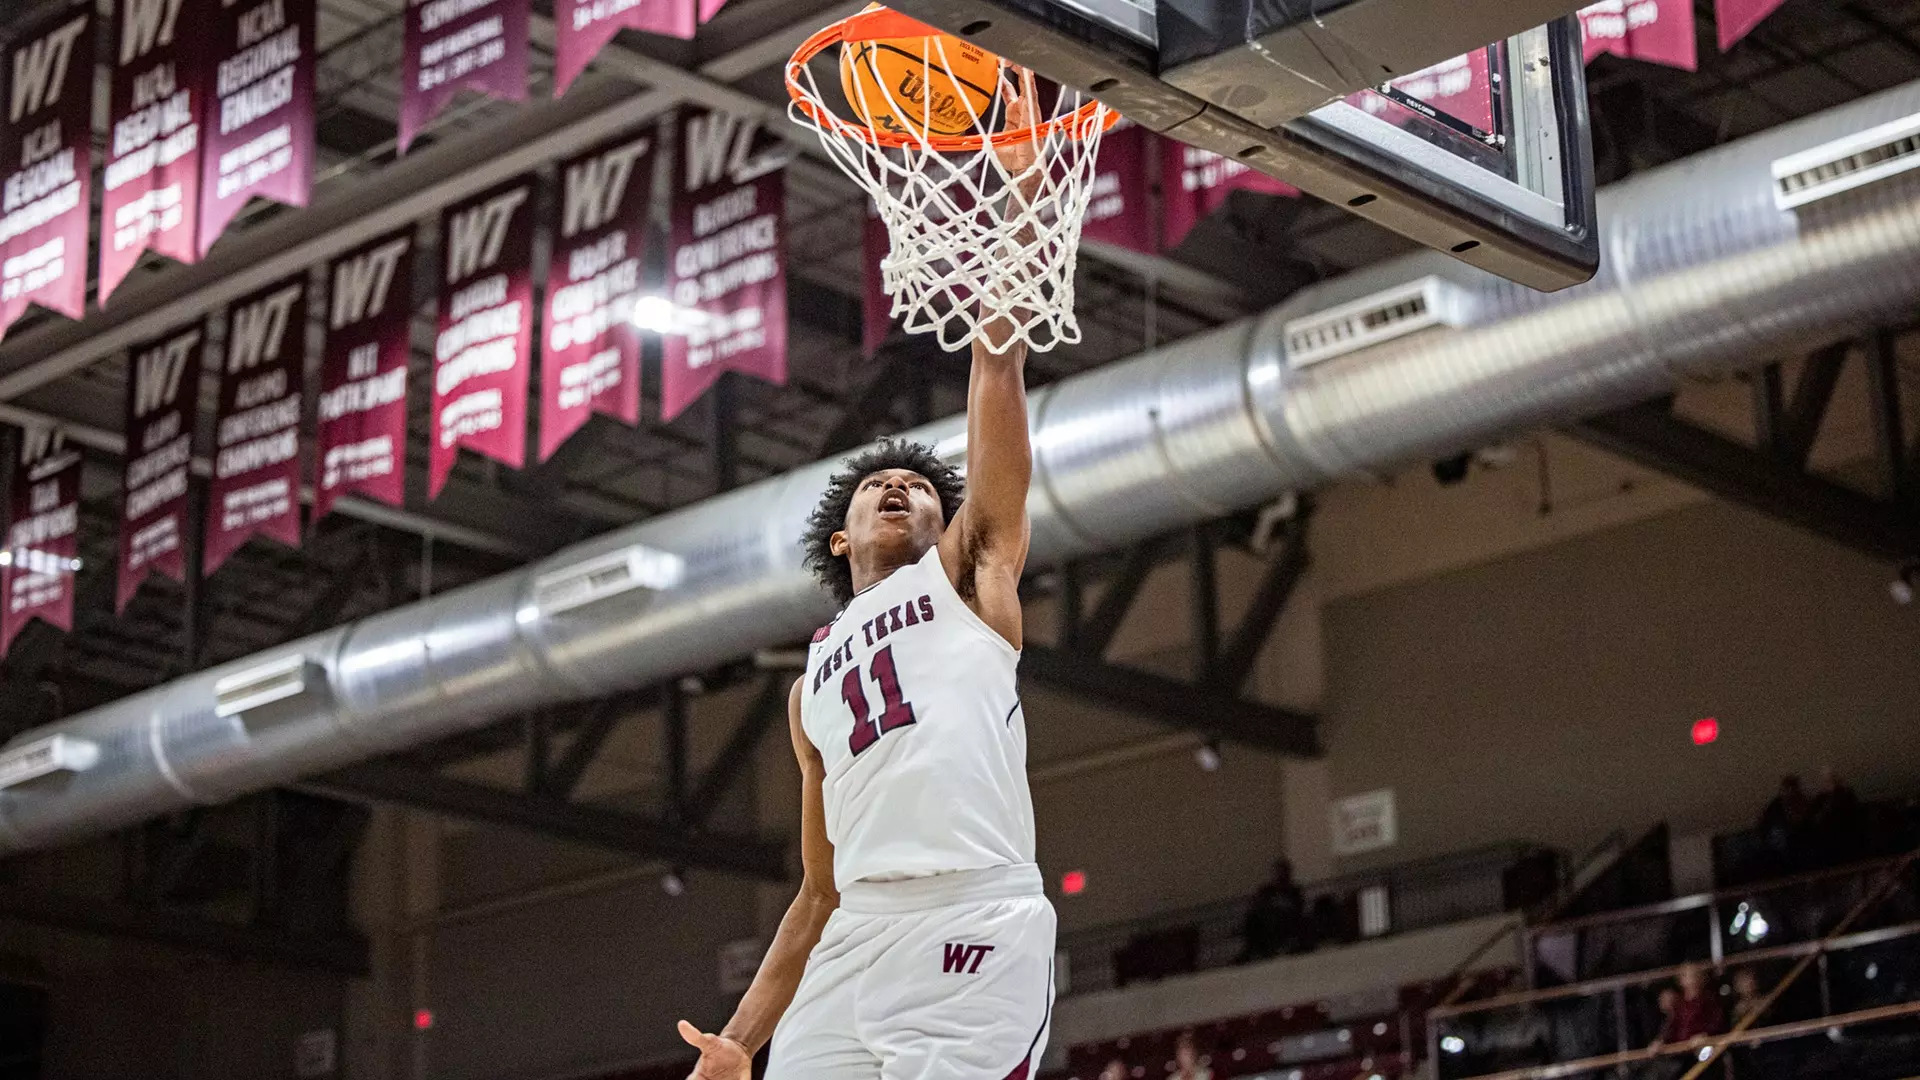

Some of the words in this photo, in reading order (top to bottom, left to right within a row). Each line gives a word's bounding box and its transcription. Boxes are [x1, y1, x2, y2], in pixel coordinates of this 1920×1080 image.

[10, 15, 88, 123] WT
[447, 185, 530, 285] WT
[561, 137, 651, 238] WT
[228, 283, 302, 374] WT
[331, 238, 411, 330] WT
[134, 330, 200, 418] WT
[813, 634, 854, 695] WEST
[862, 594, 935, 647] TEXAS
[841, 644, 917, 757] 11
[942, 943, 996, 975] WT
